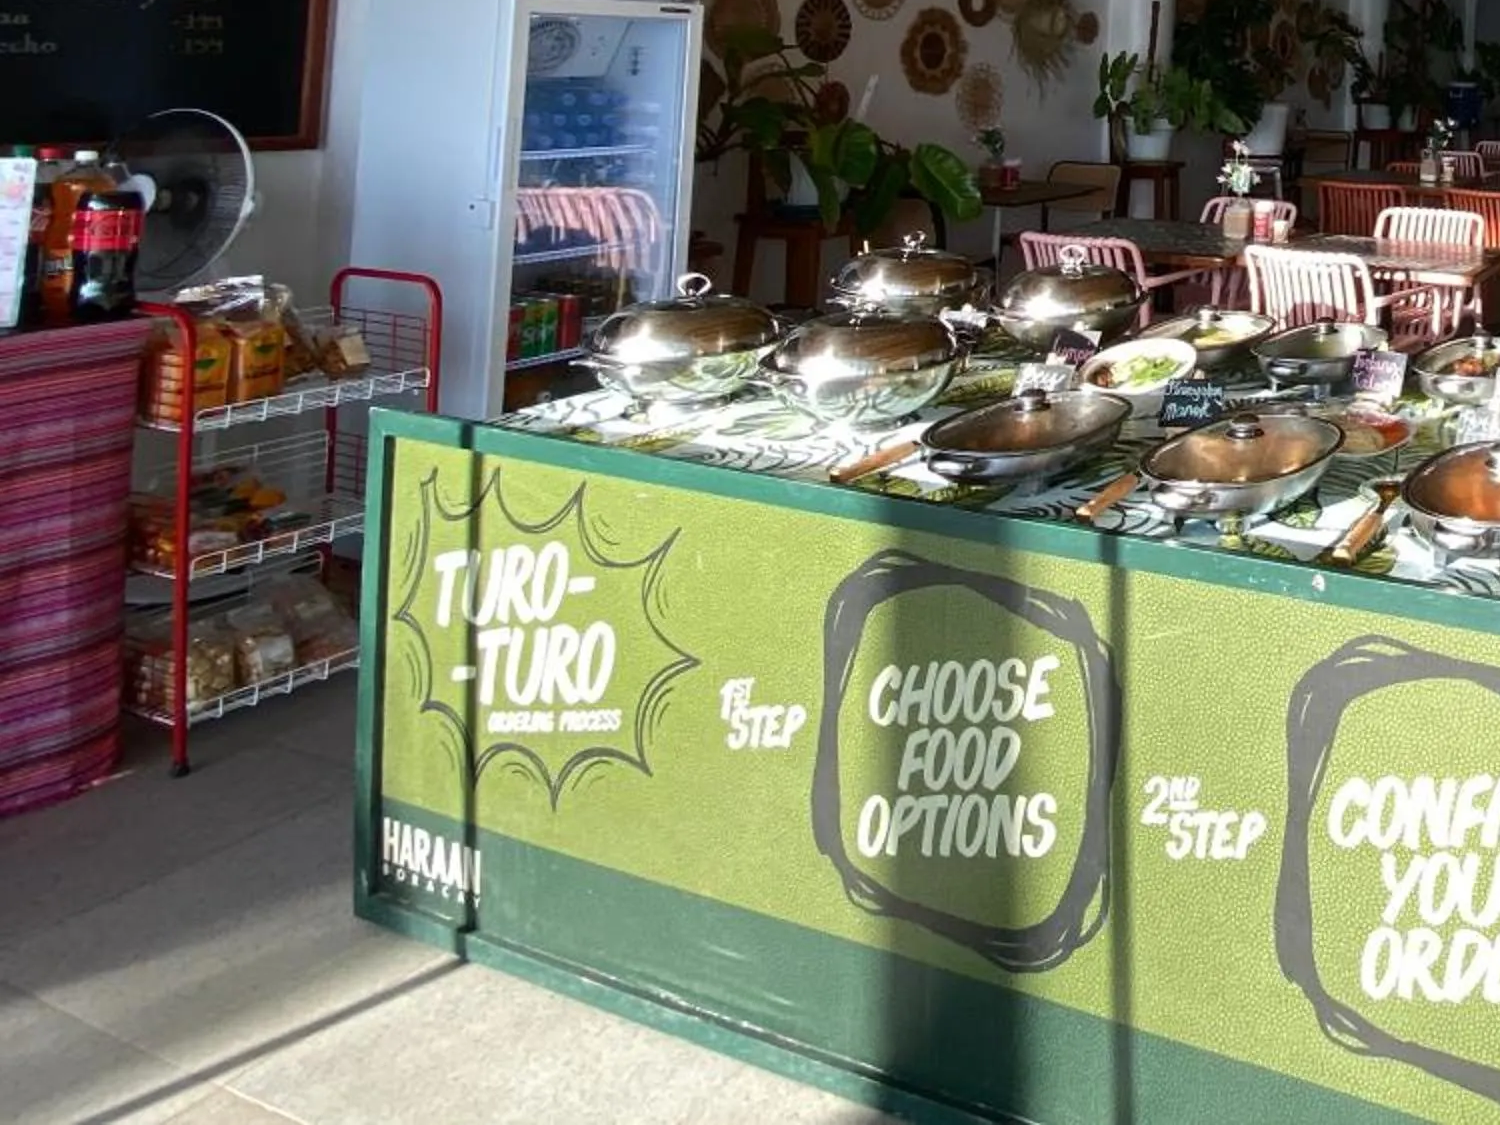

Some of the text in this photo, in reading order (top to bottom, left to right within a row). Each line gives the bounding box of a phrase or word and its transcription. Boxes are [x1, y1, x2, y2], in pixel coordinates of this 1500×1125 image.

[434, 541, 597, 628] TURO-
[450, 621, 617, 707] -TURO
[868, 654, 1061, 727] CHOOSE
[558, 708, 621, 733] PROCESS
[728, 704, 807, 750] STEP
[897, 726, 1022, 793] FOOD
[856, 792, 1058, 859] OPTIONS
[1164, 810, 1267, 862] STEP
